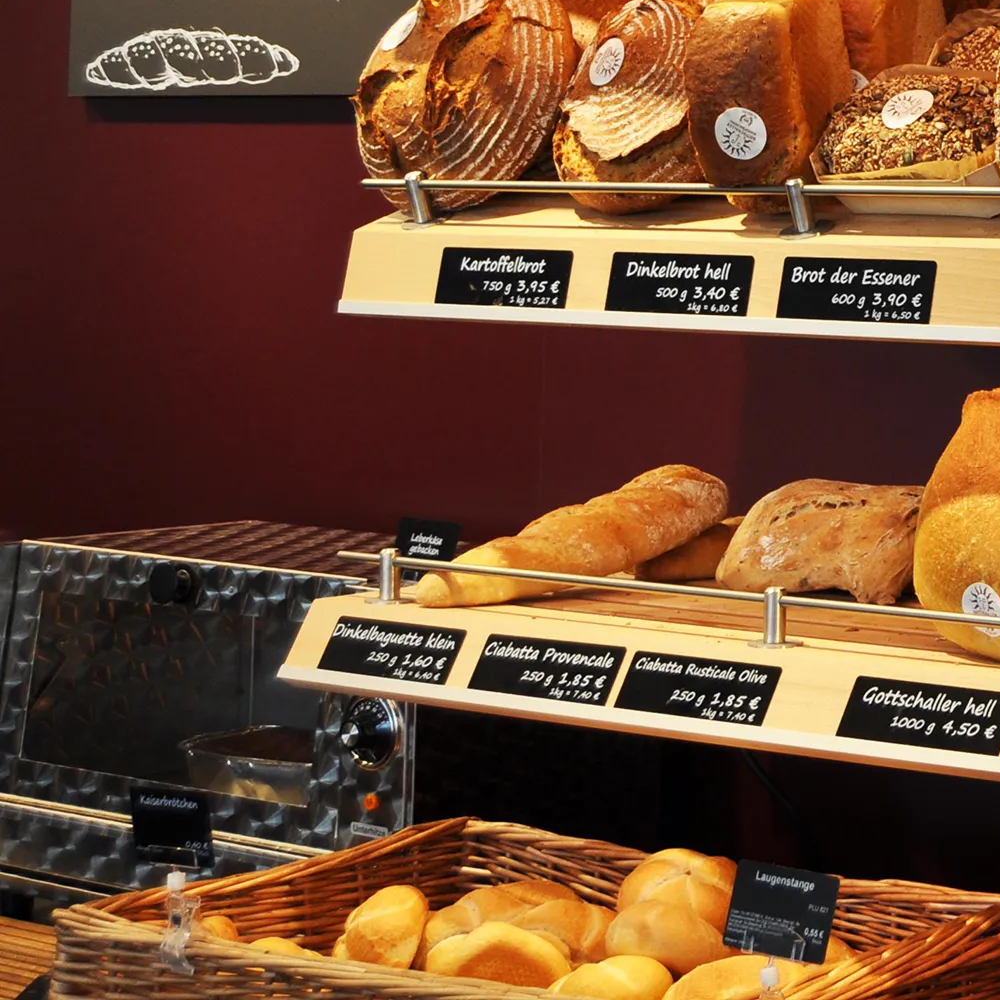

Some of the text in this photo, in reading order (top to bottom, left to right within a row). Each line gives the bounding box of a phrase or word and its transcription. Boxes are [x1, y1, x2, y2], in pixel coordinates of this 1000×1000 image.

[460, 255, 546, 273] Kartoffelbrot
[626, 260, 731, 280] Dinkelbrot hell
[791, 266, 920, 286] Brot der Essener
[483, 280, 560, 295] 750 g 3,95 €
[656, 286, 740, 302] 500 g 3,40 €
[516, 295, 550, 306] kg 5,27
[831, 293, 923, 309] 600 g 3,90 €
[872, 309, 911, 321] kg 6,50
[333, 623, 455, 650] Dinkelbaguette klein
[367, 652, 447, 670] 250 g 1,60 €
[484, 642, 614, 668] Ciabatta Provencale
[520, 670, 606, 688] 250 g 1,85 €
[635, 657, 768, 684] Ciabatta Rusticale Olive
[670, 689, 761, 710] 250 g 1,85 €
[862, 686, 998, 718] Gottschaller hell
[891, 716, 998, 739] 1000 g 4,50 €
[755, 870, 815, 892] Laugenstange
[804, 927, 825, 939] 0,55 €
